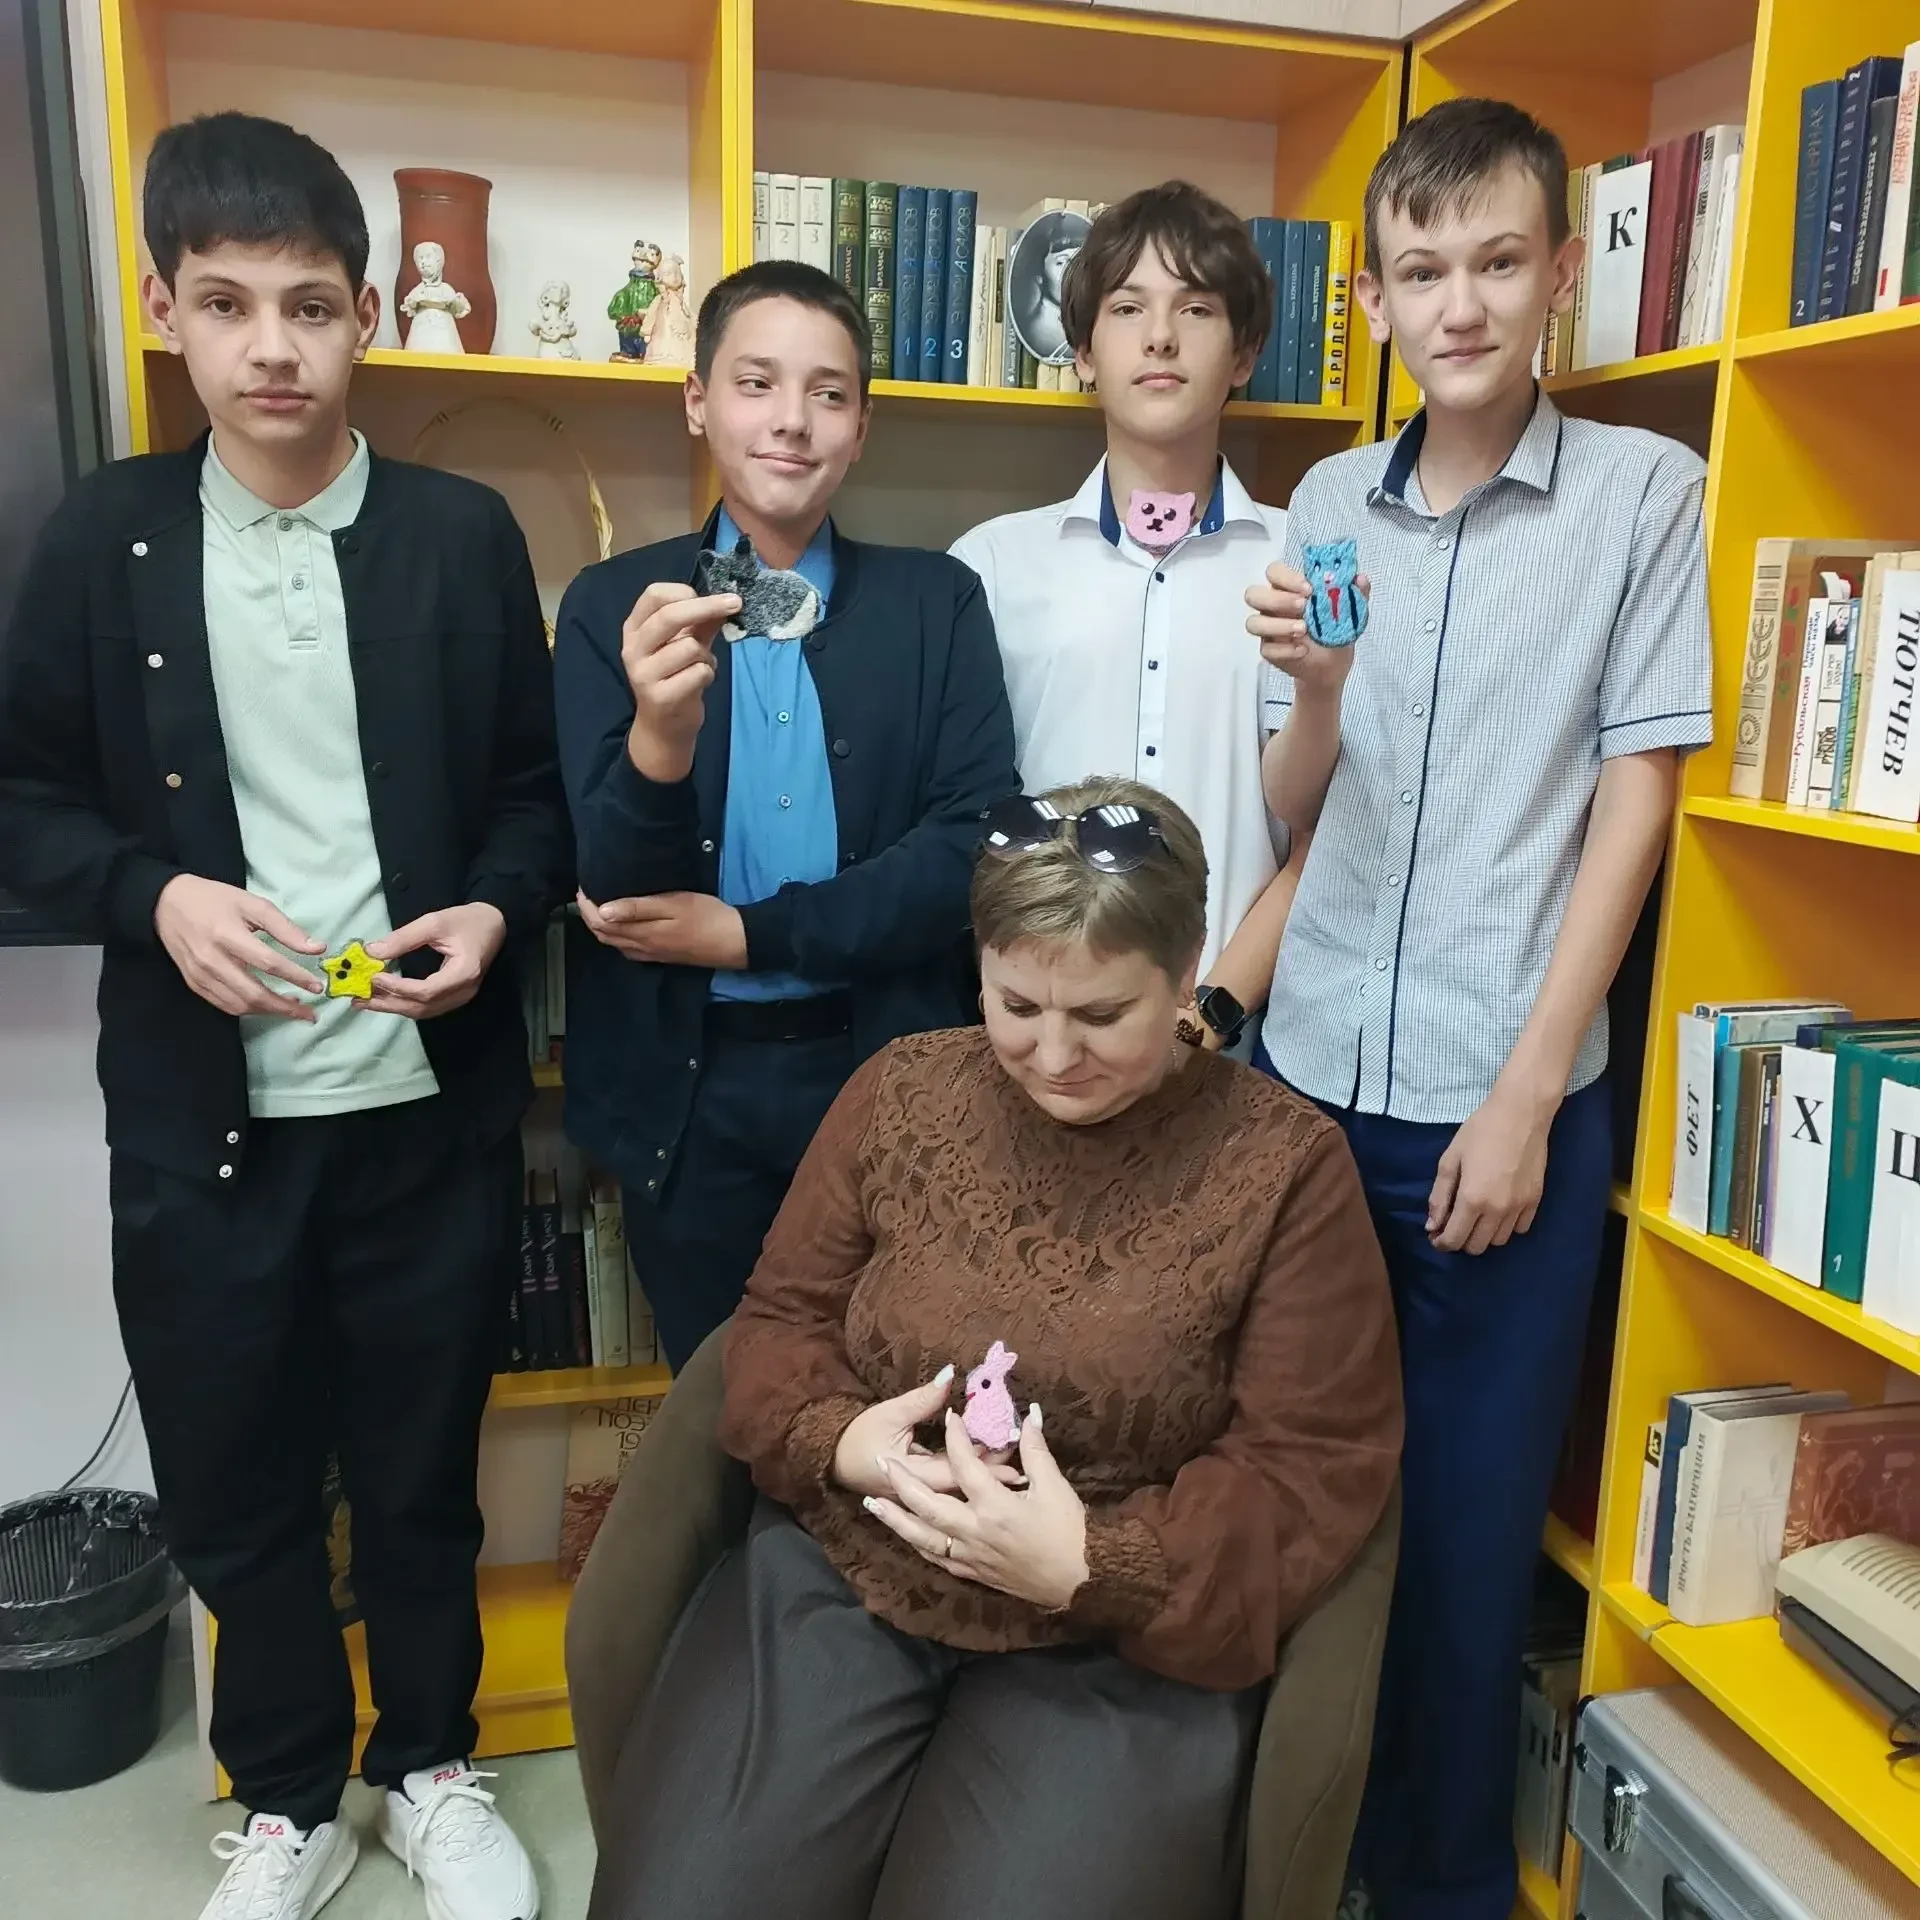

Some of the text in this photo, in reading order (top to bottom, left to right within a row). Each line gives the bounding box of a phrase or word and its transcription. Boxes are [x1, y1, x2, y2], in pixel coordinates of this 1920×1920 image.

[1803, 102, 1824, 218] ПАСТЕРНАК
[1605, 205, 1638, 255] К
[1795, 299, 1805, 317] 2
[903, 336, 912, 356] 1
[924, 337, 937, 357] 2
[950, 338, 963, 359] 3
[1329, 279, 1347, 385] БРОДСКИЙ
[1883, 607, 1920, 777] ТЮТЧЕВ
[1793, 675, 1811, 757] Рубальская
[1685, 1083, 1701, 1156] ФЕТ
[1791, 1094, 1825, 1146] Х
[1832, 1254, 1843, 1273] 1
[615, 1431, 641, 1449] 19
[1677, 1432, 1706, 1593] ЯРОСТЬ БЛАГОРОДНАЯ
[432, 1766, 461, 1785] FILA
[256, 1822, 284, 1836] FILA
